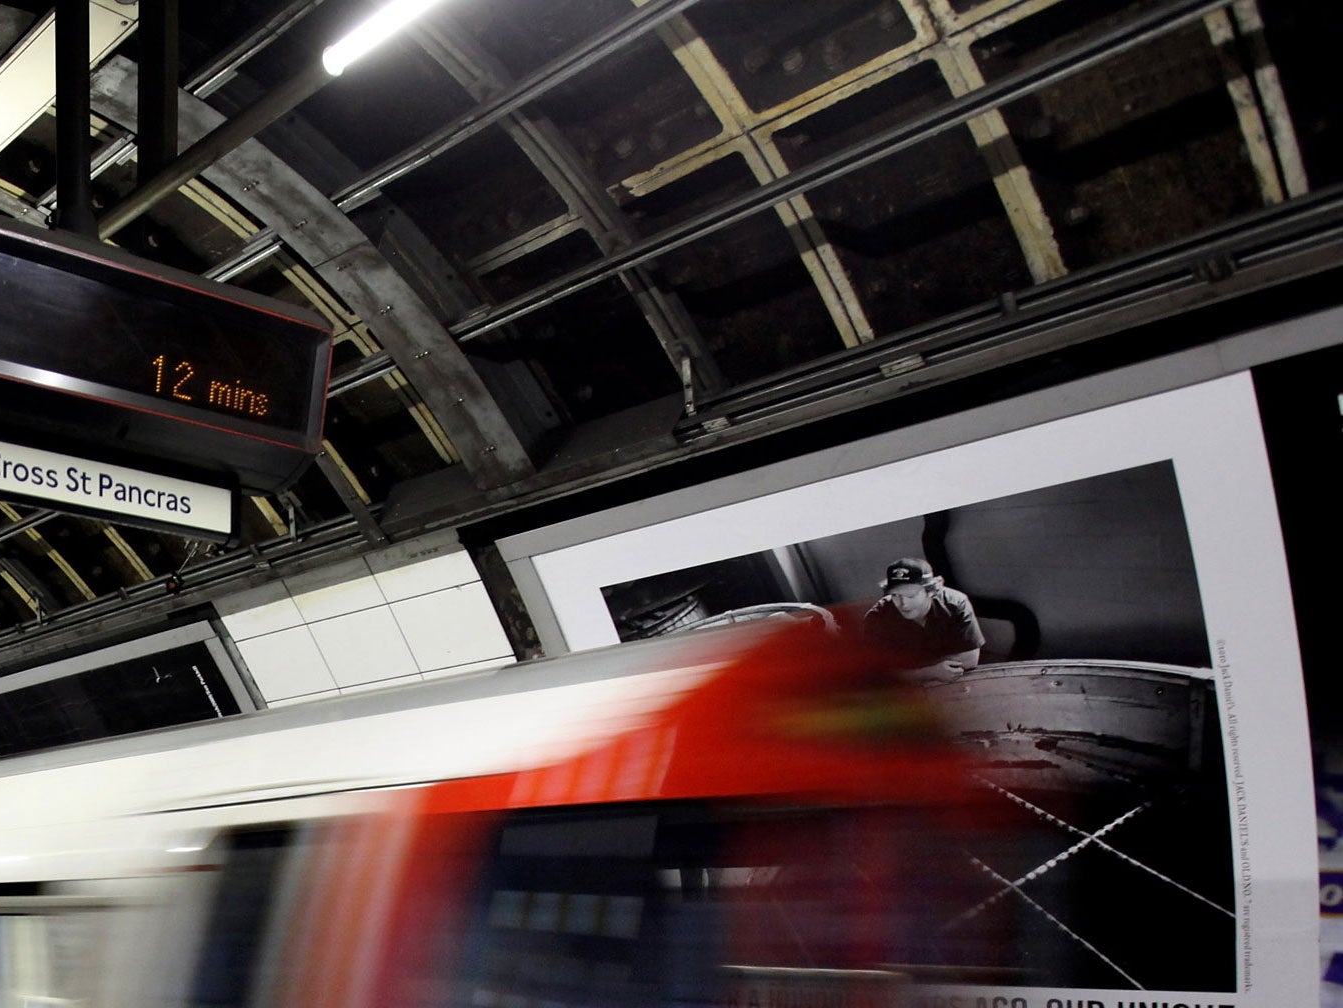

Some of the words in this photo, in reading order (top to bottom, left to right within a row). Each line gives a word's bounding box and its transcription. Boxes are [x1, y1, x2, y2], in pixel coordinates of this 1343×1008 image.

[151, 354, 195, 401] 12
[208, 379, 269, 417] mins
[65, 466, 93, 496] St
[97, 474, 194, 516] Pancras
[1228, 726, 1240, 748] rights
[1232, 780, 1246, 802] JACK
